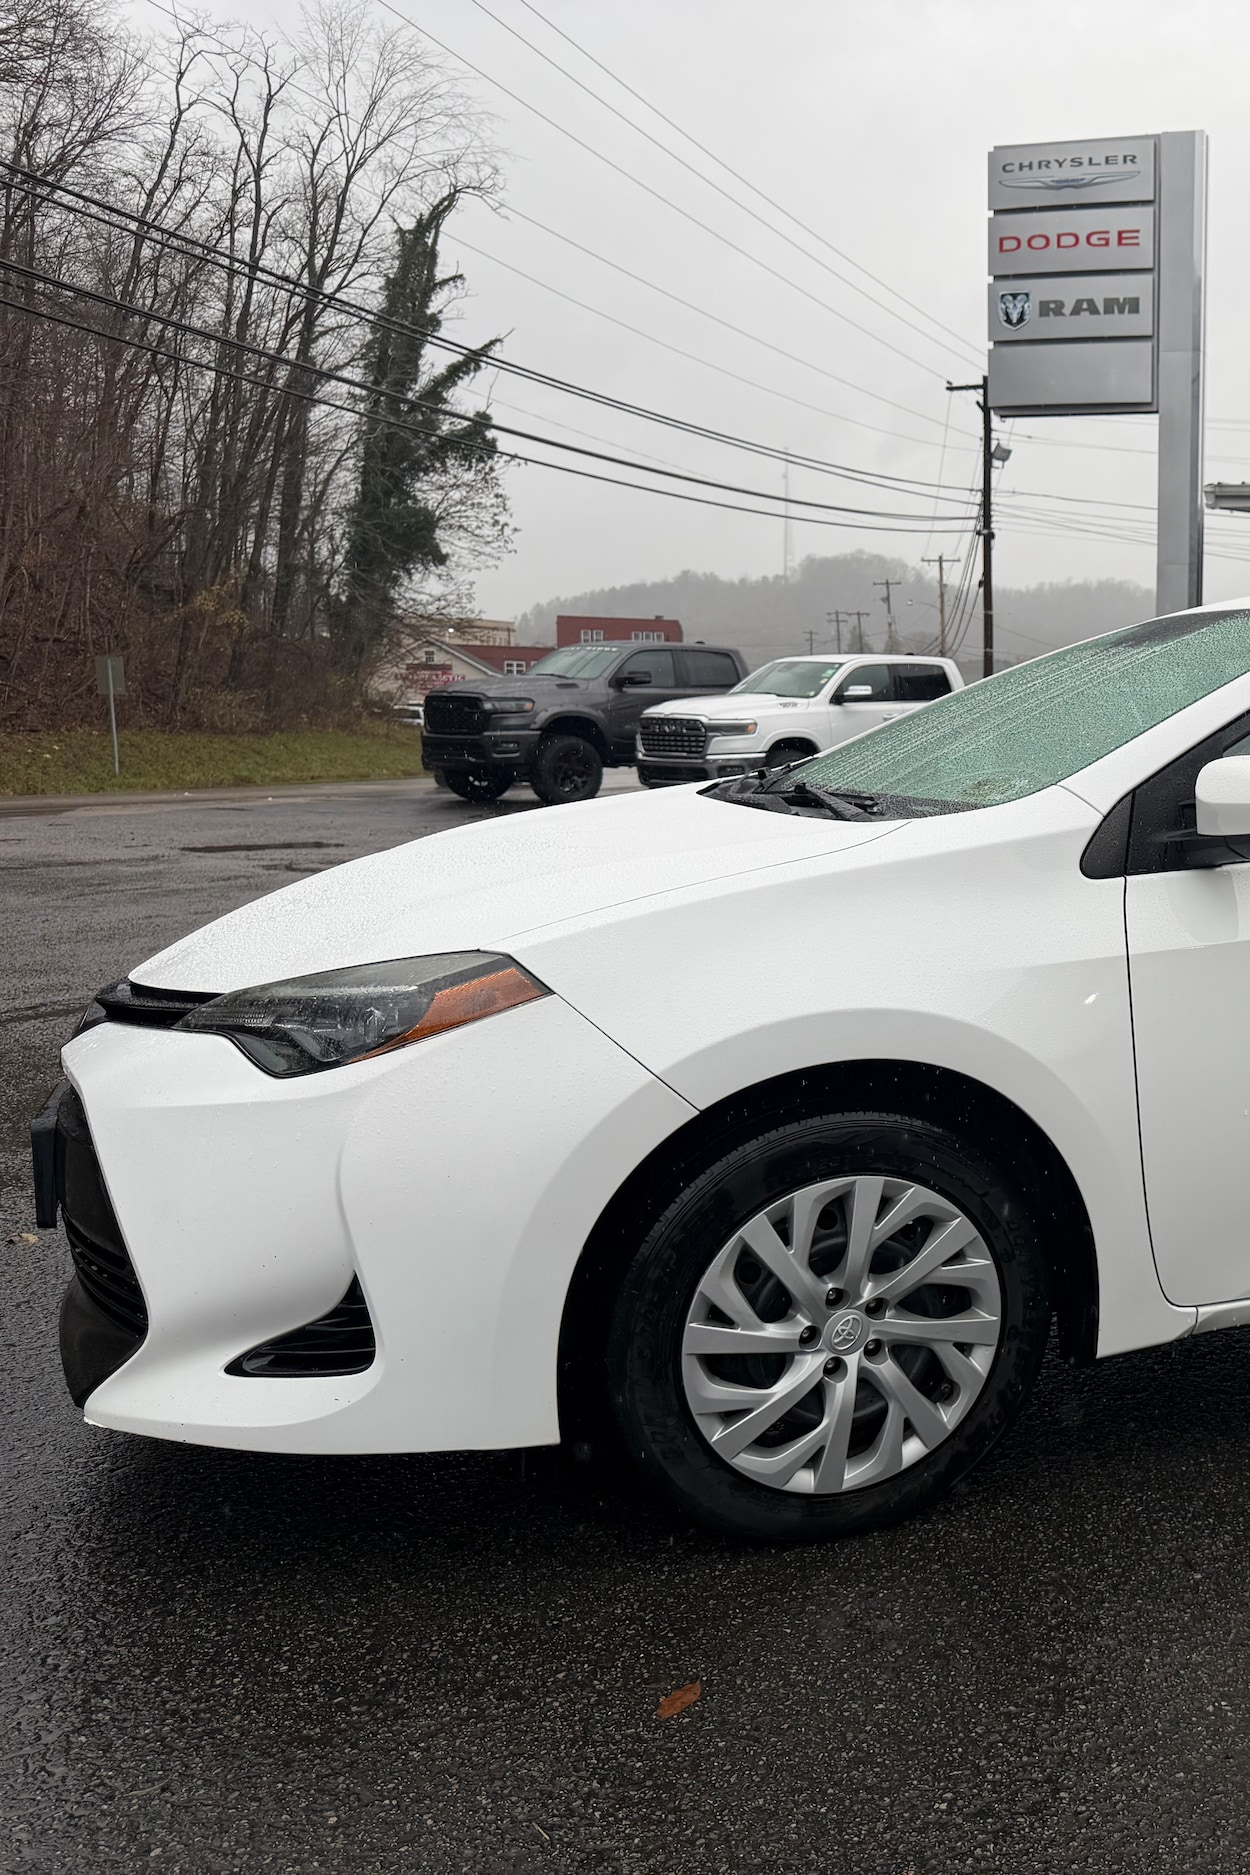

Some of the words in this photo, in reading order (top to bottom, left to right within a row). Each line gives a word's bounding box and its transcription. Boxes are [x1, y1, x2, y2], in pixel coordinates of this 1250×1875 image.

[1001, 154, 1138, 173] CHRYSLER
[999, 229, 1141, 253] DODGE
[1038, 297, 1140, 318] RAM
